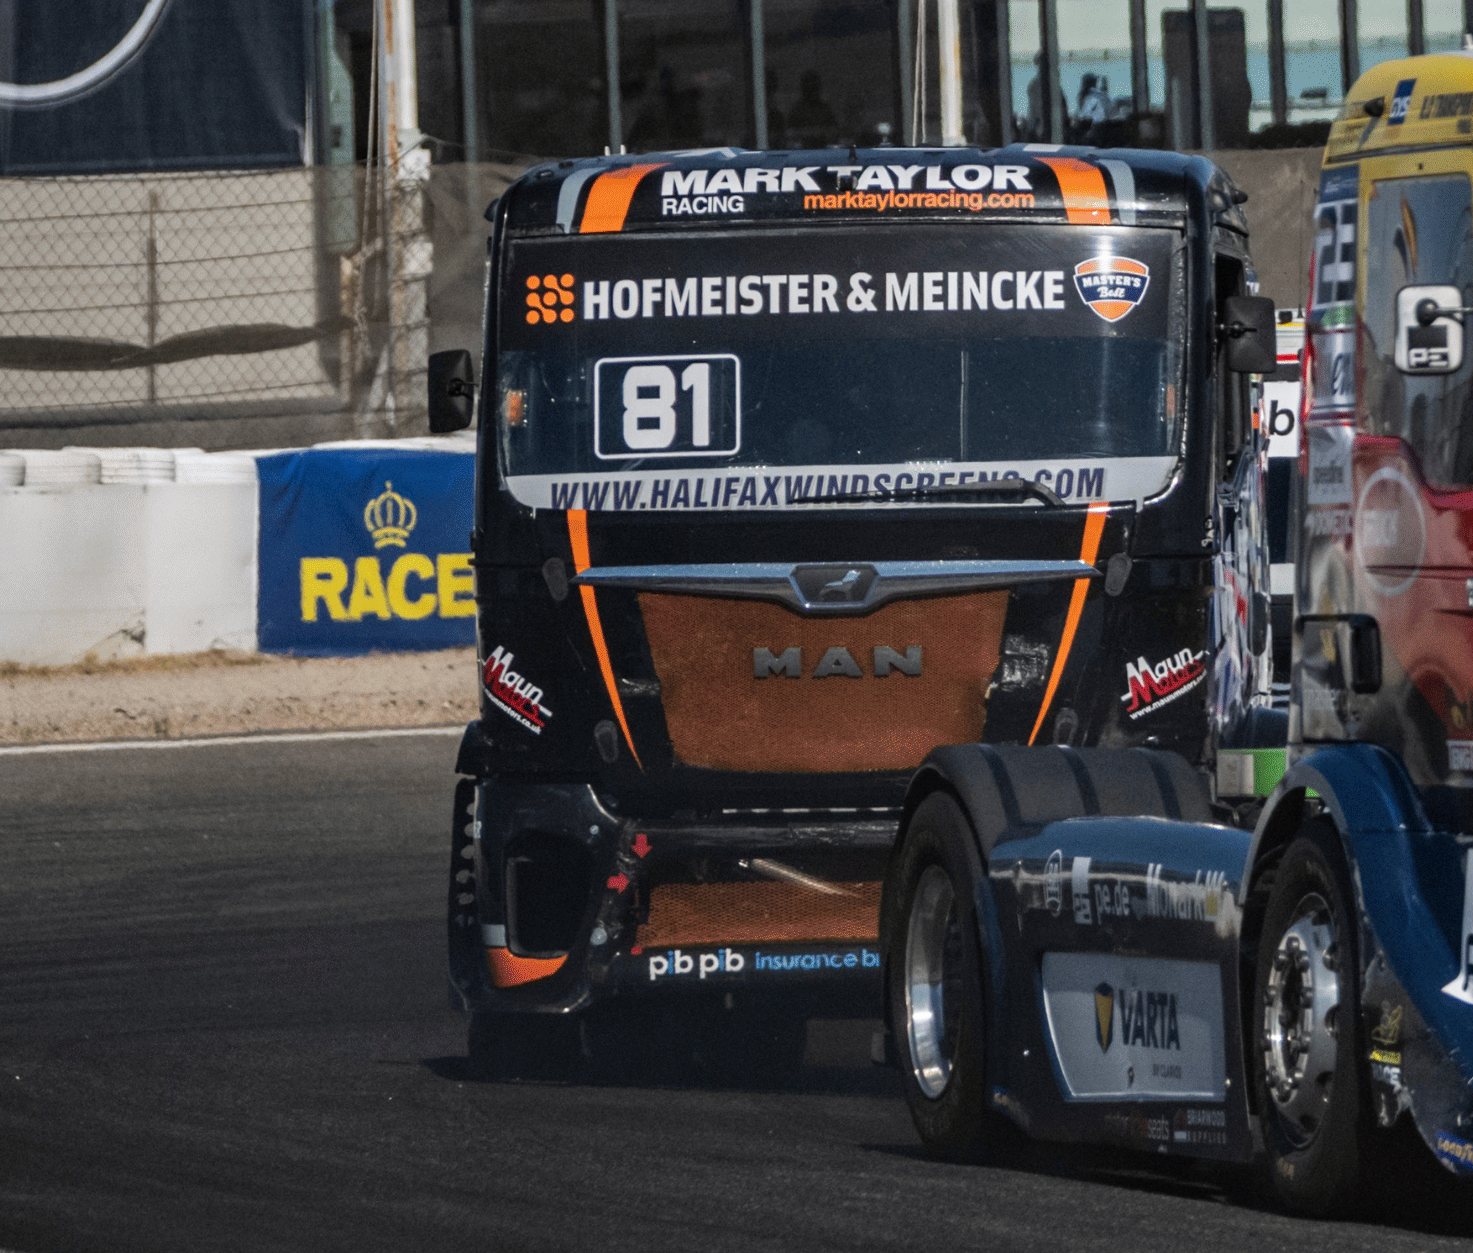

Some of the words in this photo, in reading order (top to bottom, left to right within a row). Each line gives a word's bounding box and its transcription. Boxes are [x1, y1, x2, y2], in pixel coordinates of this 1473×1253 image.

[660, 168, 822, 197] MARK
[826, 164, 1033, 191] TAYLOR
[661, 195, 745, 215] RACING
[803, 189, 1035, 213] marktaylorracing.com
[583, 274, 839, 320] HOFMEISTER
[846, 272, 879, 312] &
[885, 269, 1065, 312] MEINCKE
[621, 361, 711, 450] 81
[300, 553, 477, 622] RACE
[752, 645, 923, 679] MAN
[754, 951, 859, 971] insurance
[1118, 988, 1181, 1050] VARTA
